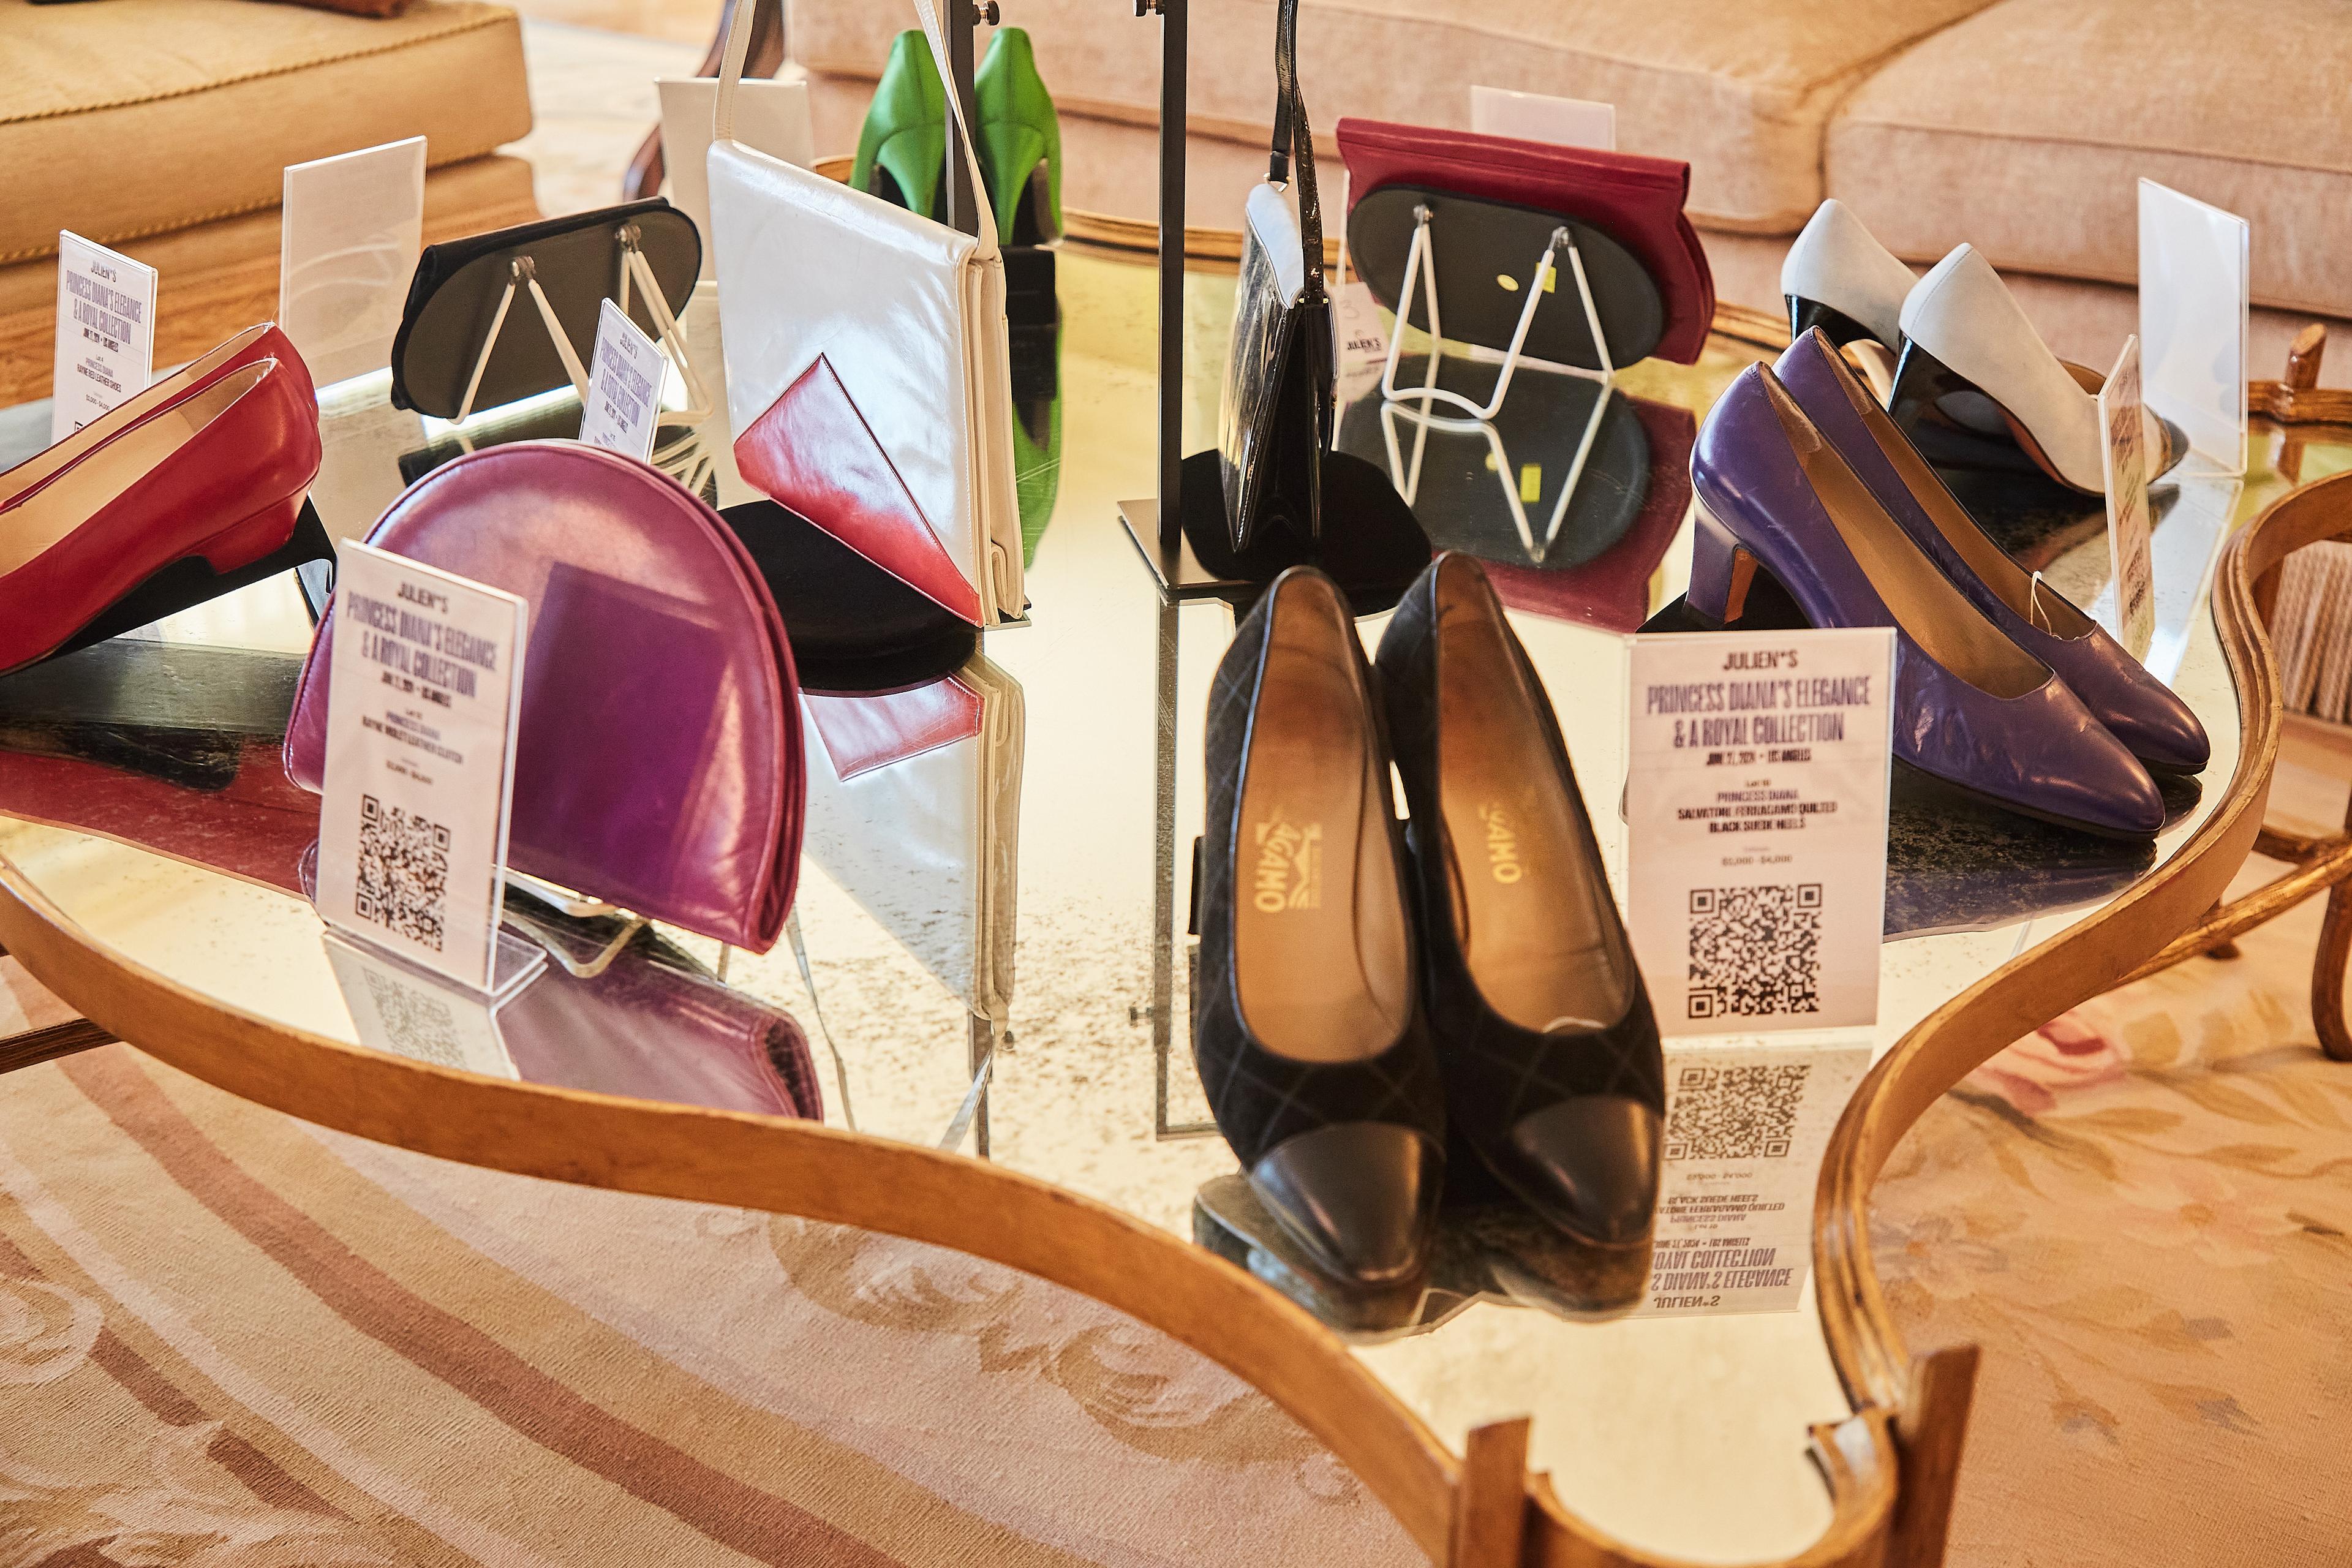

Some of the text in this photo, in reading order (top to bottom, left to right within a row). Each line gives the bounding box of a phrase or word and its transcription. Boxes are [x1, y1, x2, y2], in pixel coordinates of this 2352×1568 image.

[66, 270, 141, 324] PRINCESS DIANA'S ELEGANCE
[73, 298, 130, 345] & A ROYAL COLLECTION
[95, 372, 109, 387] LEATHER
[110, 379, 121, 393] SHOES
[413, 648, 477, 698] COLLECTION
[1648, 676, 1871, 714] PRINCESS DIANA'S ELEGANCE
[1674, 713, 1844, 748] & A ROYAL COLLECTION
[1718, 790, 1799, 803] PRINCESS DIANA
[1735, 804, 1796, 818] FERRAGAMO
[1799, 801, 1838, 816] QUILTED
[1709, 821, 1741, 833] BLACK
[1777, 817, 1805, 829] HEELS
